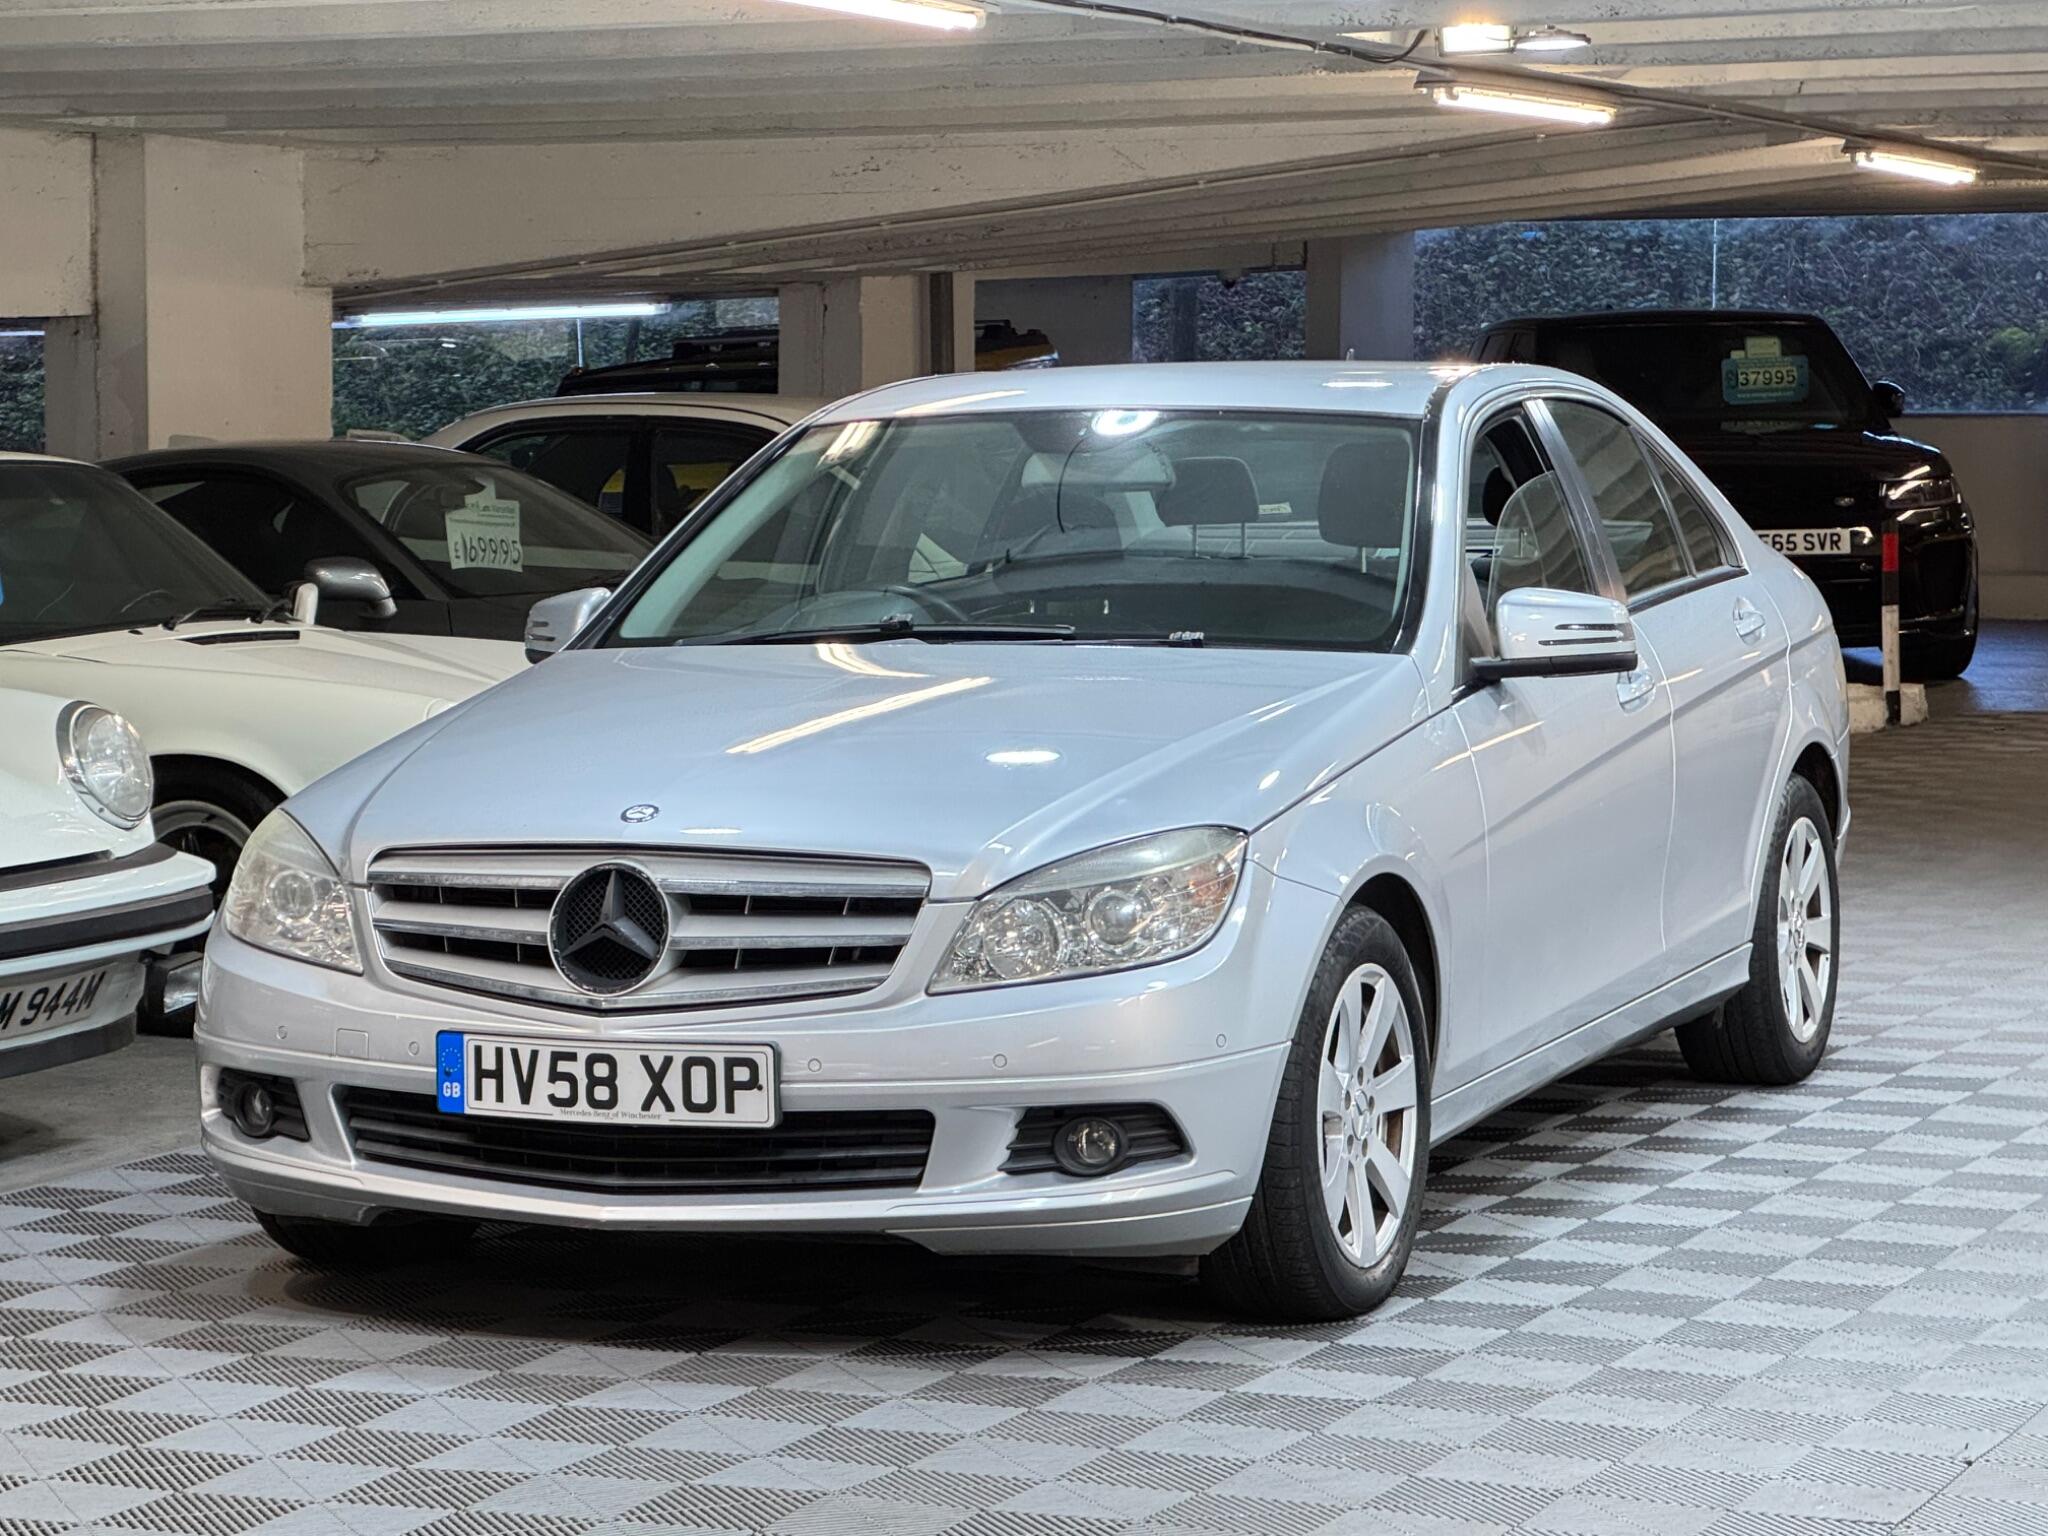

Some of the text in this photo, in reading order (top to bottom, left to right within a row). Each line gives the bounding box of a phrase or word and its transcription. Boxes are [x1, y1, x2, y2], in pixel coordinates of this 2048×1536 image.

[1739, 368, 1797, 387] 37995
[1803, 533, 1842, 551] SVR
[20, 971, 107, 1026] 944M
[473, 1045, 759, 1114] HV58 XOP
[442, 1081, 461, 1098] GB
